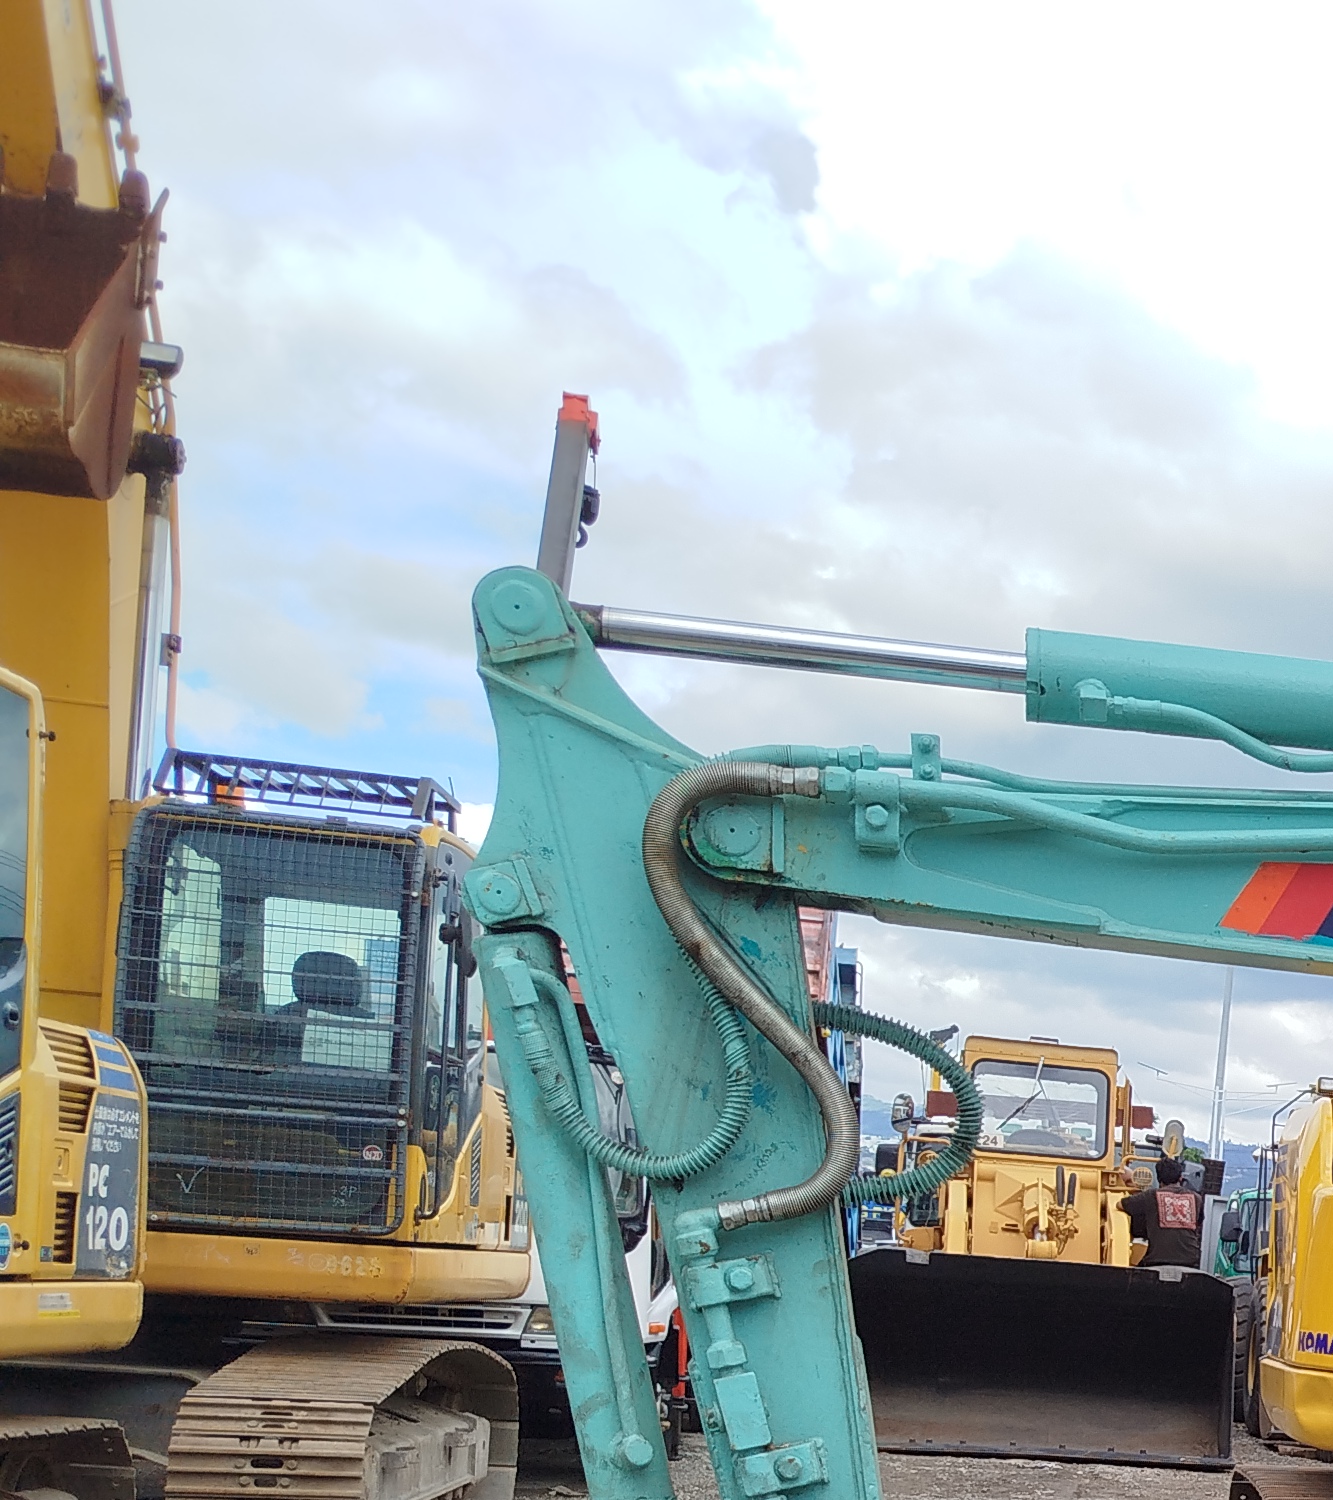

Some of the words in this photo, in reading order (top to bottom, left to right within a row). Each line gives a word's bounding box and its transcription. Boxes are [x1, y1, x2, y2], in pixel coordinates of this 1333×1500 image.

[976, 1134, 998, 1147] 24
[88, 1163, 110, 1198] PC
[86, 1206, 129, 1251] 120
